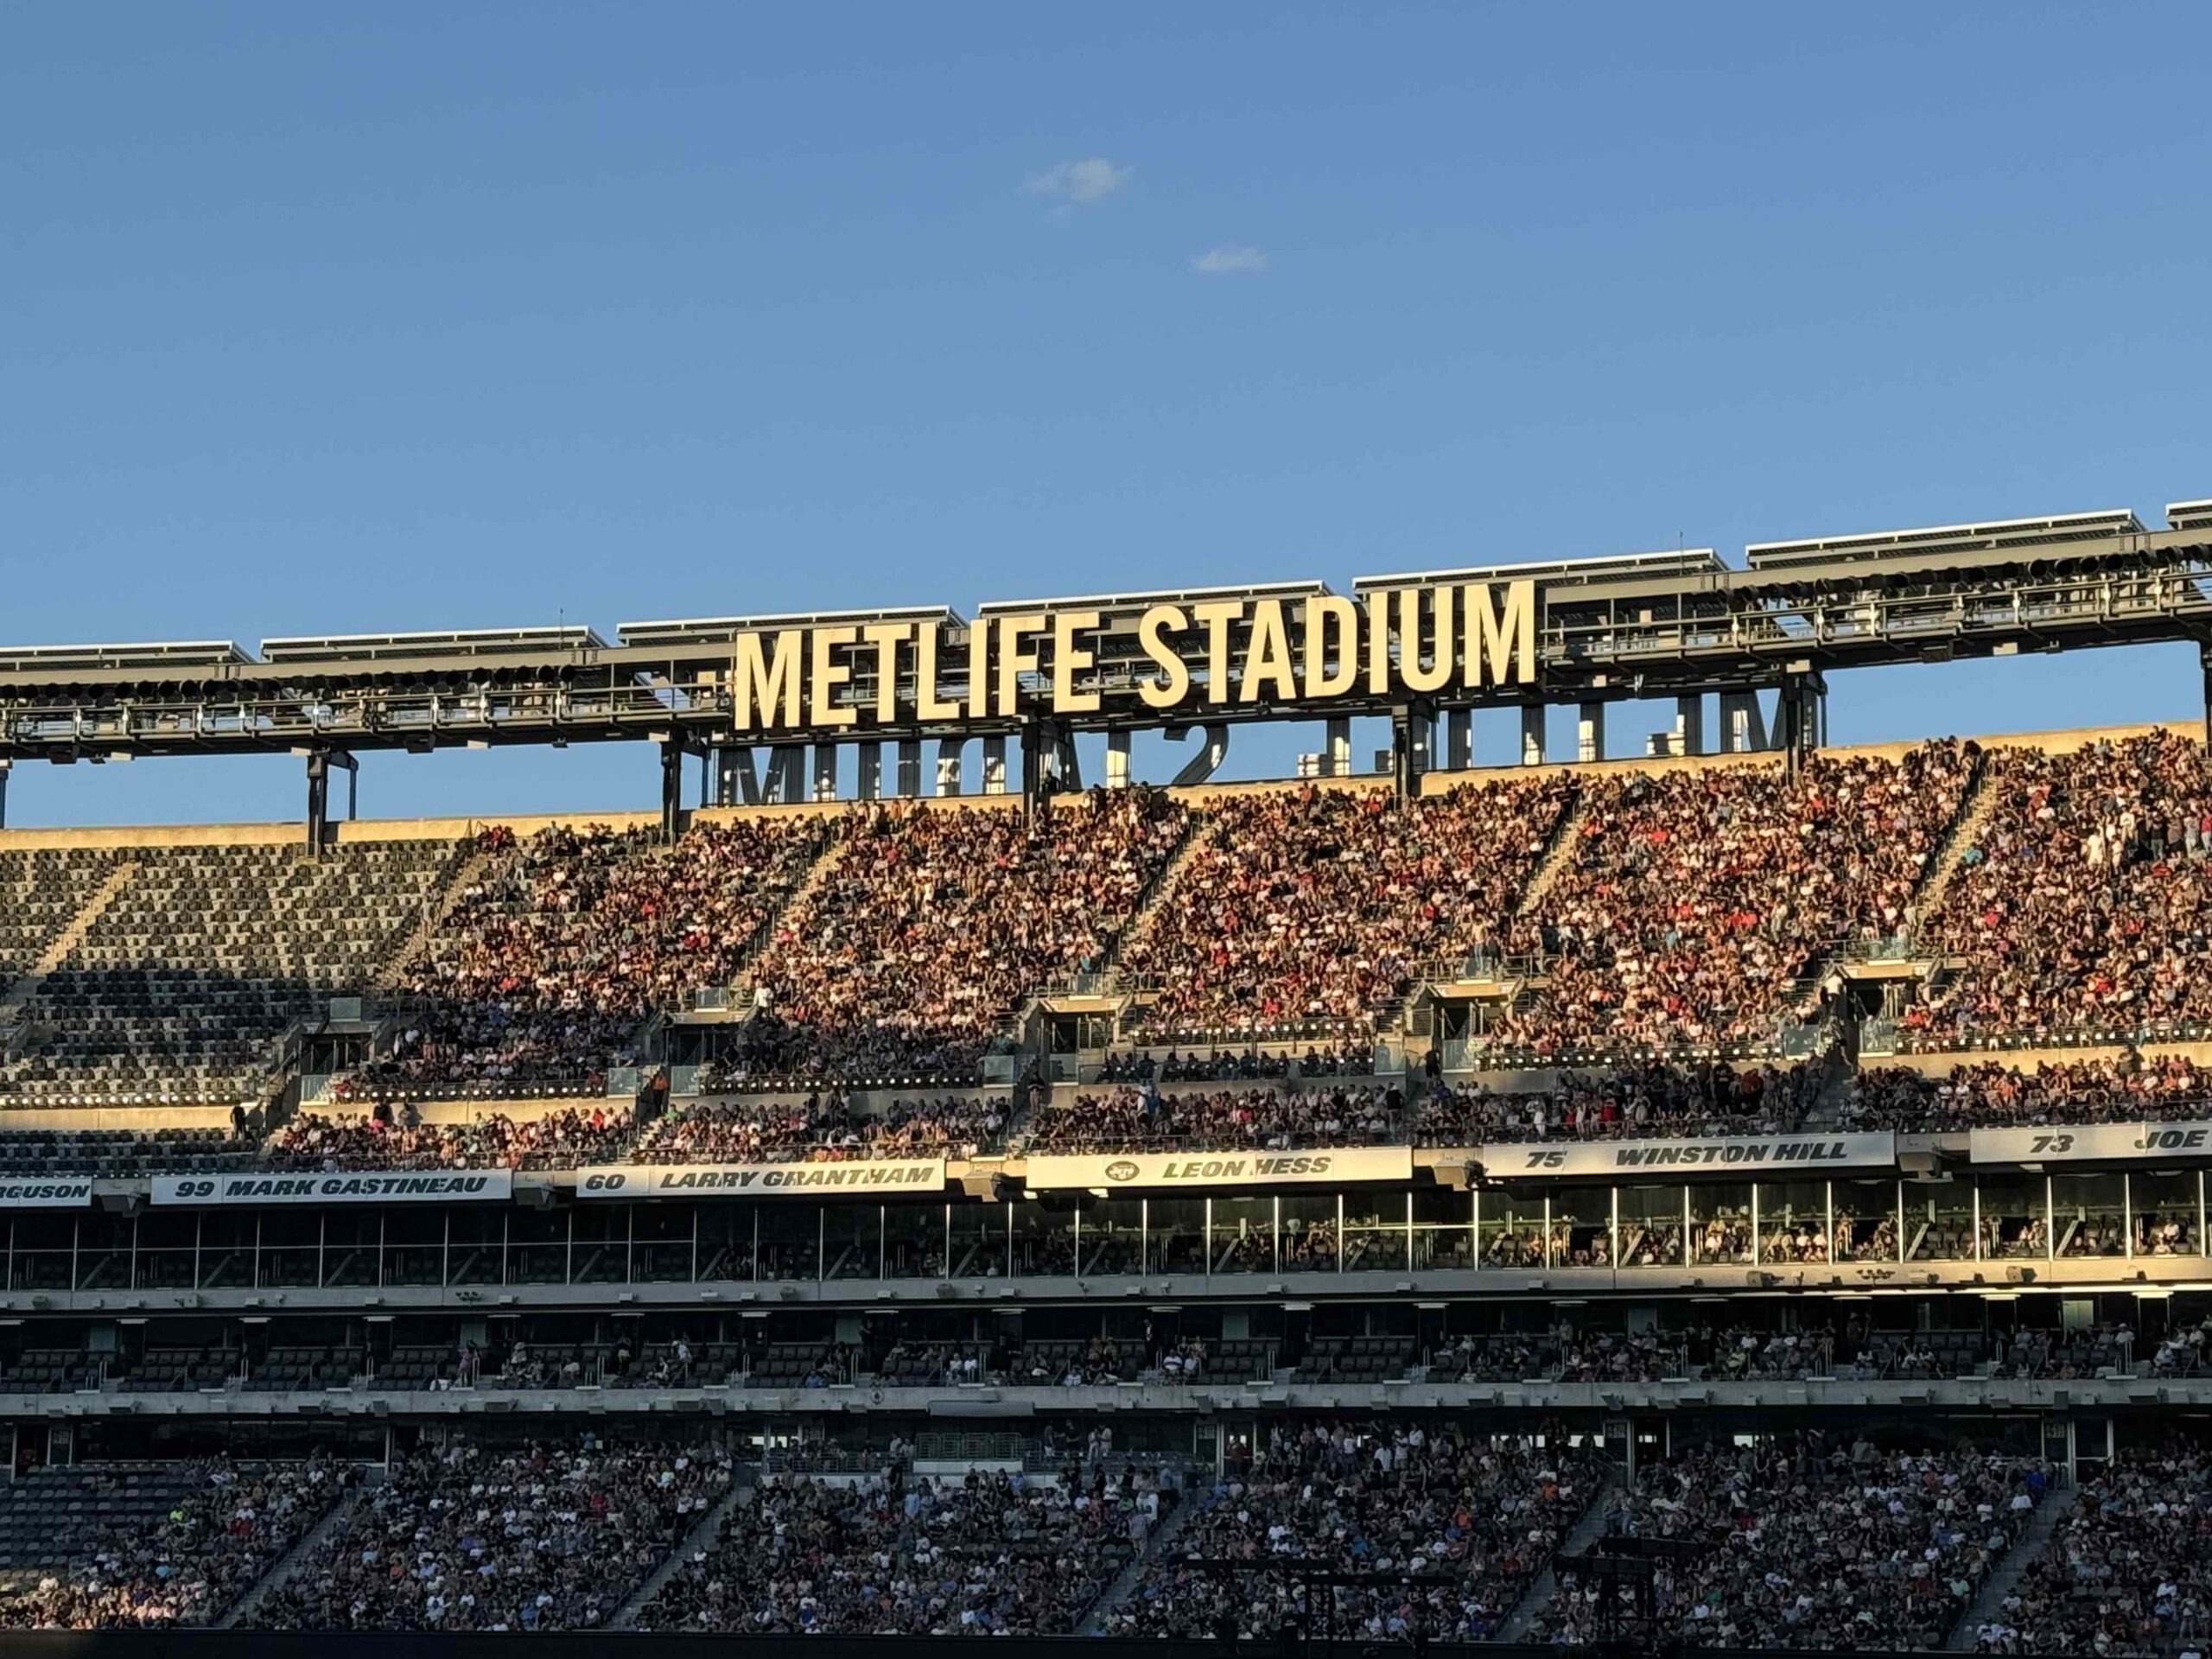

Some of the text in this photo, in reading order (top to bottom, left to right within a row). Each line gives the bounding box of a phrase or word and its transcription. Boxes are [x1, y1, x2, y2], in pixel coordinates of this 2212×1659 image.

[734, 580, 1535, 730] METLIFE STADIUM
[2030, 1129, 2209, 1154] 73 JOE
[1525, 1141, 1847, 1168] 75 WINSTON HILL
[586, 1167, 934, 1190] 60 LARRY GRANTHAM
[1163, 1157, 1332, 1178] LEON HESS
[175, 1177, 487, 1197] 99 MARK GASTINEAU
